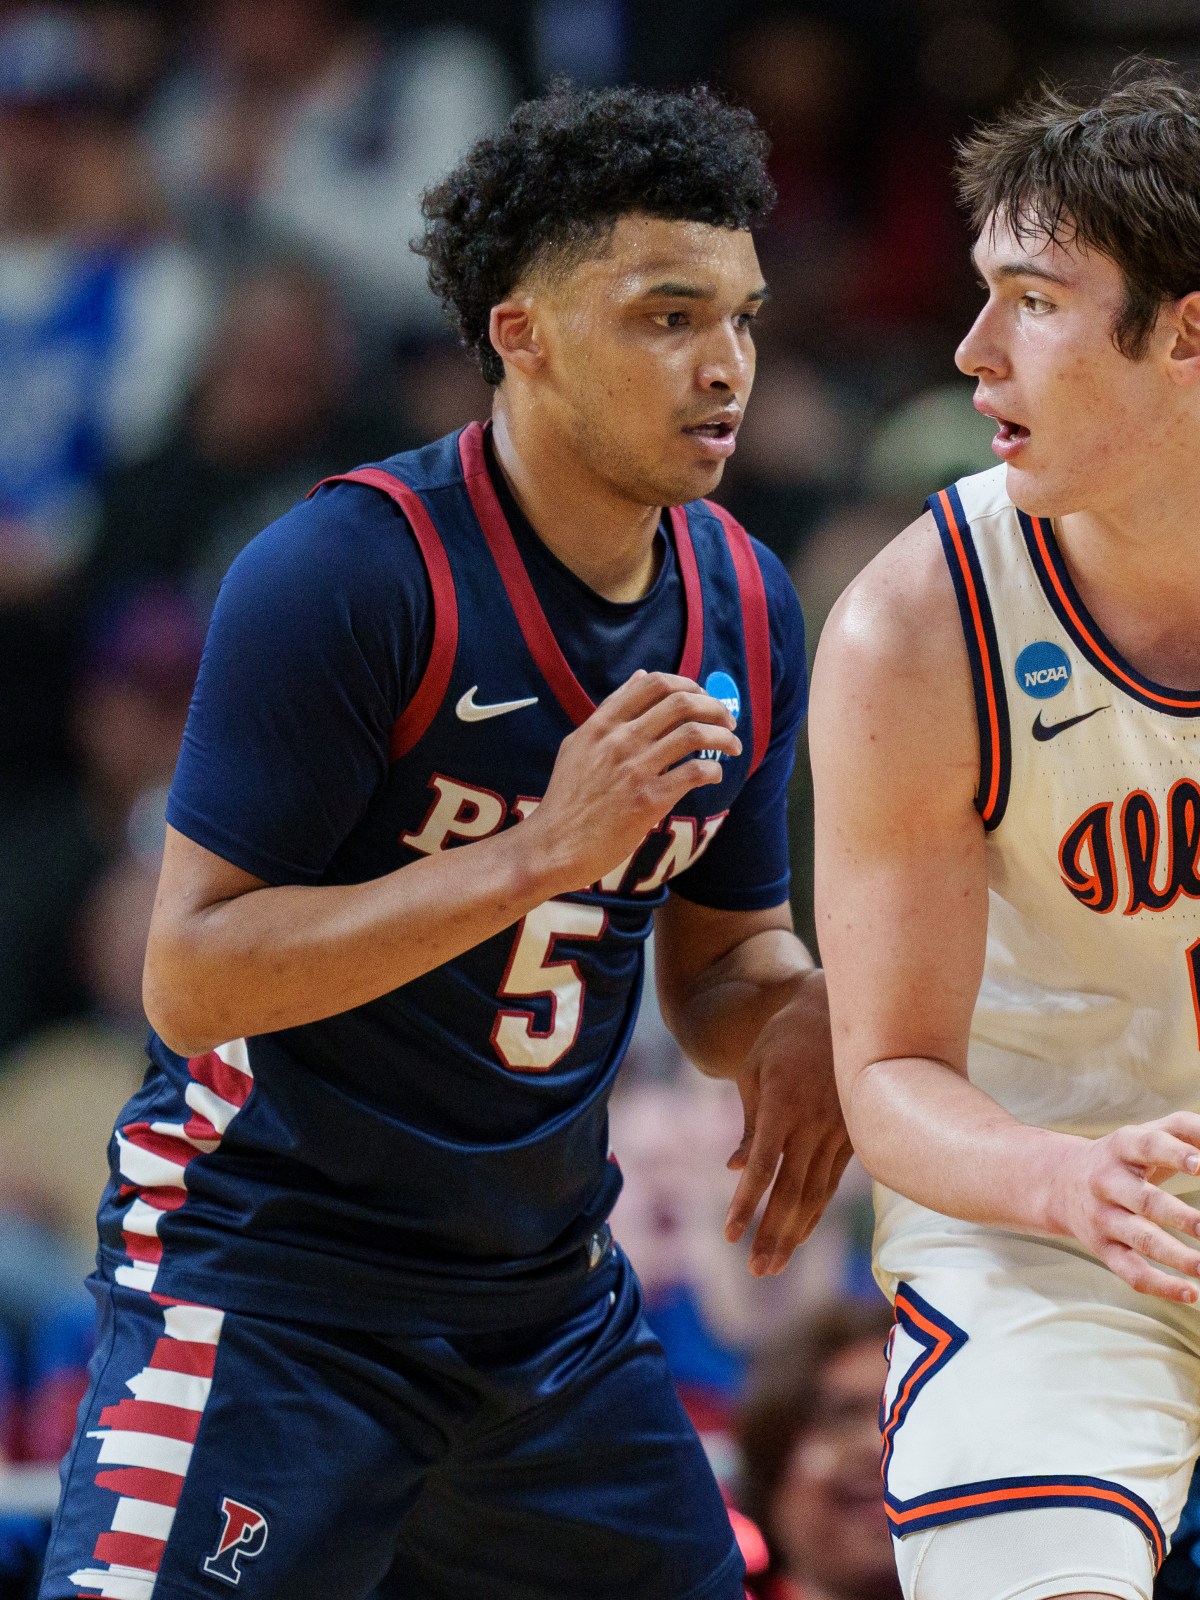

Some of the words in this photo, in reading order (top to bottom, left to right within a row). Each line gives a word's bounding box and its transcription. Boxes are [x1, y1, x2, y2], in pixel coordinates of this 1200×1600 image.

[1024, 665, 1069, 687] NCAA
[401, 772, 730, 895] PN
[489, 900, 609, 1074] 5
[203, 1496, 269, 1585] P
